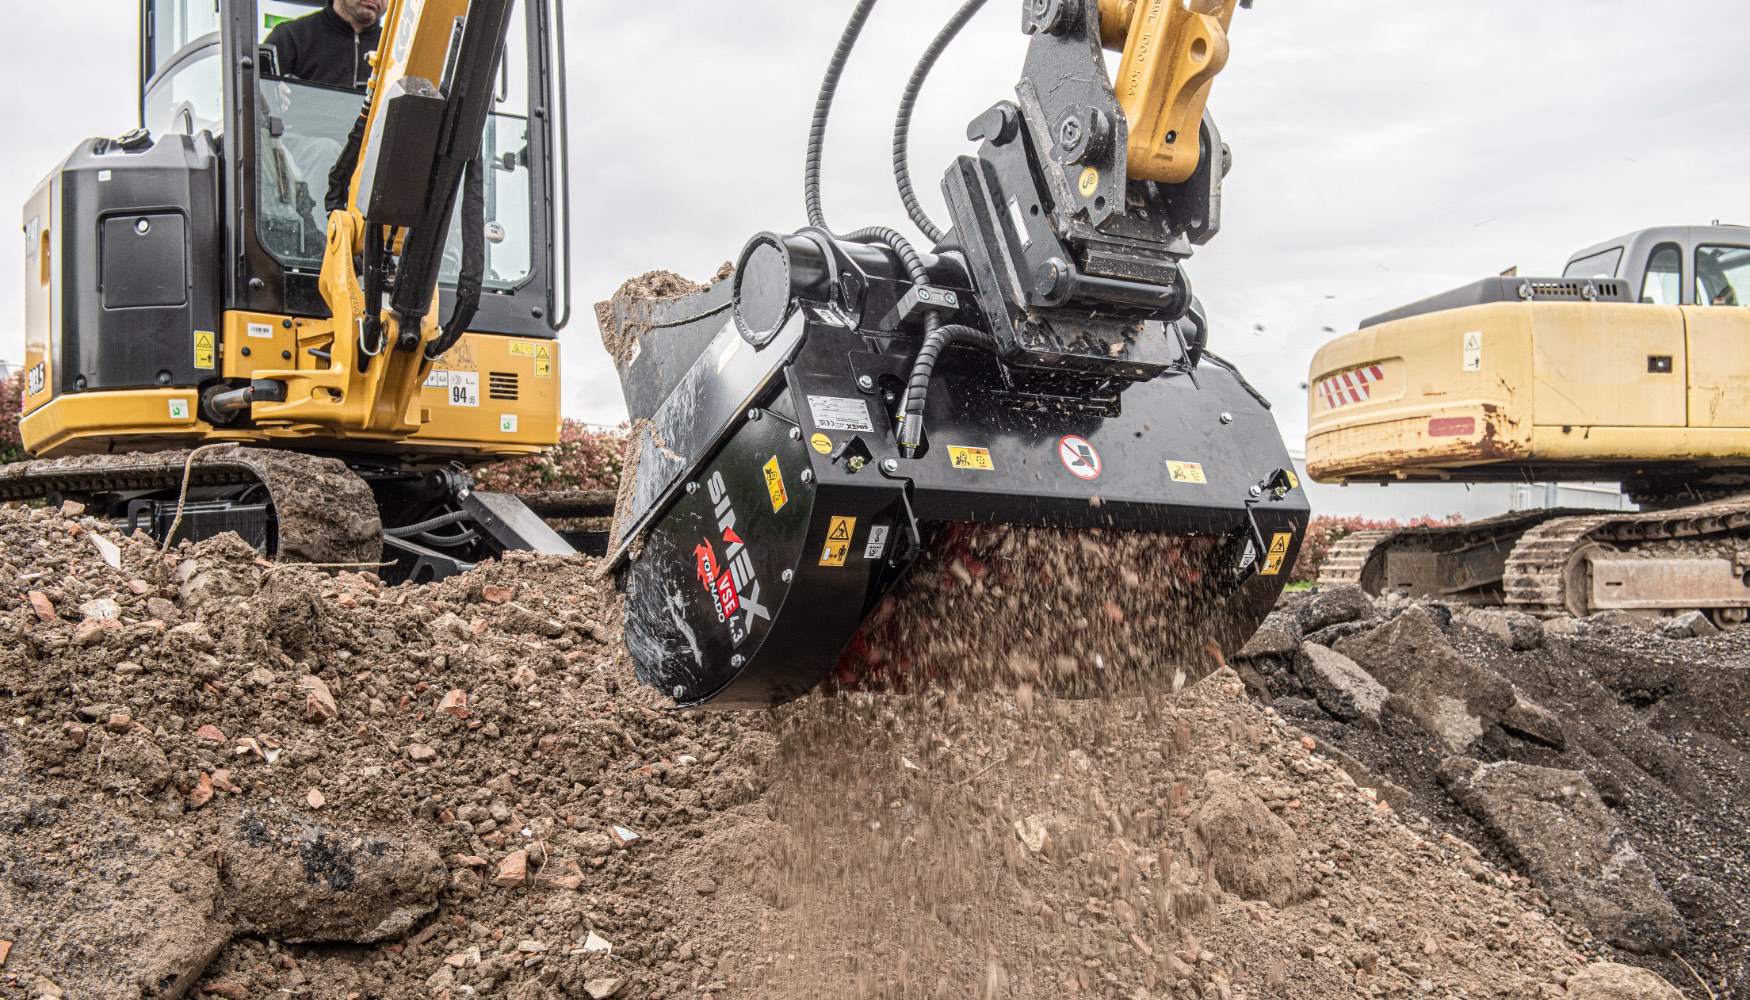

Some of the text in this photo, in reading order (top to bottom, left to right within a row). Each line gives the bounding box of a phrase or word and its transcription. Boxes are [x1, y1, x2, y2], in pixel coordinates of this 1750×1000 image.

[1138, 33, 1151, 62] 1000
[453, 387, 467, 403] 94
[707, 470, 770, 634] SIMEX
[701, 552, 726, 623] TORNADO
[718, 575, 743, 643] VSE 4.3
